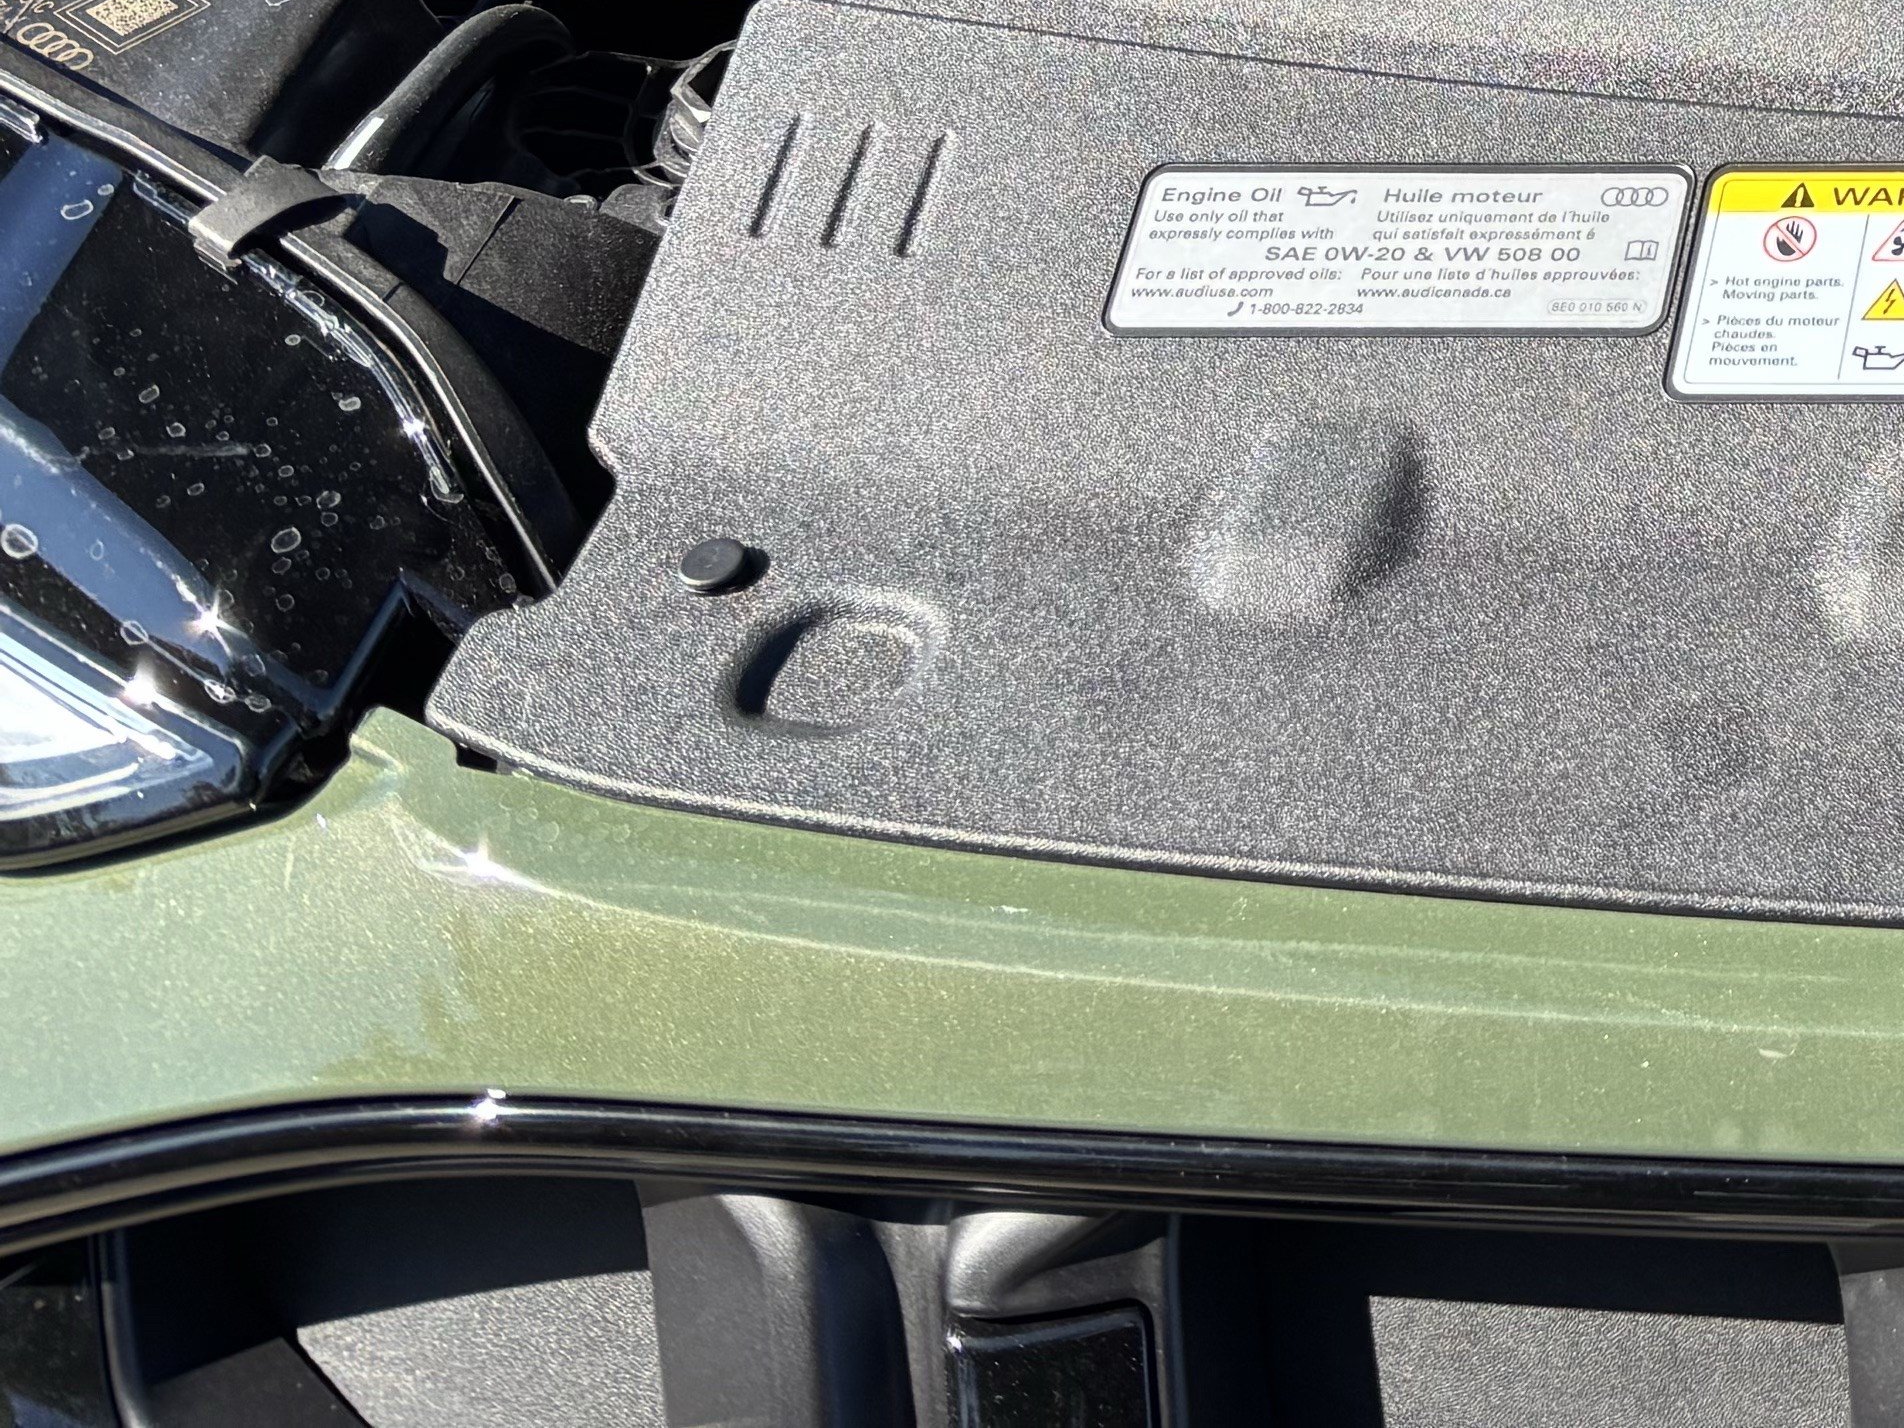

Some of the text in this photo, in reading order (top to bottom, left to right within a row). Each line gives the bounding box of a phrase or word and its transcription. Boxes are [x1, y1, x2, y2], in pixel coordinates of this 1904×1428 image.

[1161, 187, 1543, 205] Engine Oil Huile moteur
[1154, 210, 1284, 224] Use only oil that
[1376, 210, 1434, 224] Utilisez
[1438, 211, 1534, 226] uniquement
[1538, 211, 1558, 224] de
[1149, 227, 1334, 242] expressly complies with
[1372, 228, 1399, 243] qui
[1402, 228, 1464, 241] satisfait
[1264, 246, 1580, 262] SAE 0W-20 & VW 508 00
[1136, 268, 1342, 283] For a list of approved oils:
[1361, 268, 1399, 280] Pour
[1403, 271, 1431, 280] une
[1437, 268, 1470, 280] liste
[1725, 276, 1750, 287] Hot
[1754, 276, 1801, 289] engine
[1131, 284, 1274, 298] www.audiusa.com
[1356, 286, 1511, 298] www.audicanada.ca
[1722, 289, 1776, 302] Moving
[1250, 303, 1364, 315] 1-800-822-2834
[1717, 314, 1840, 327] Pièces du moteur
[1712, 341, 1778, 353] Pièces en
